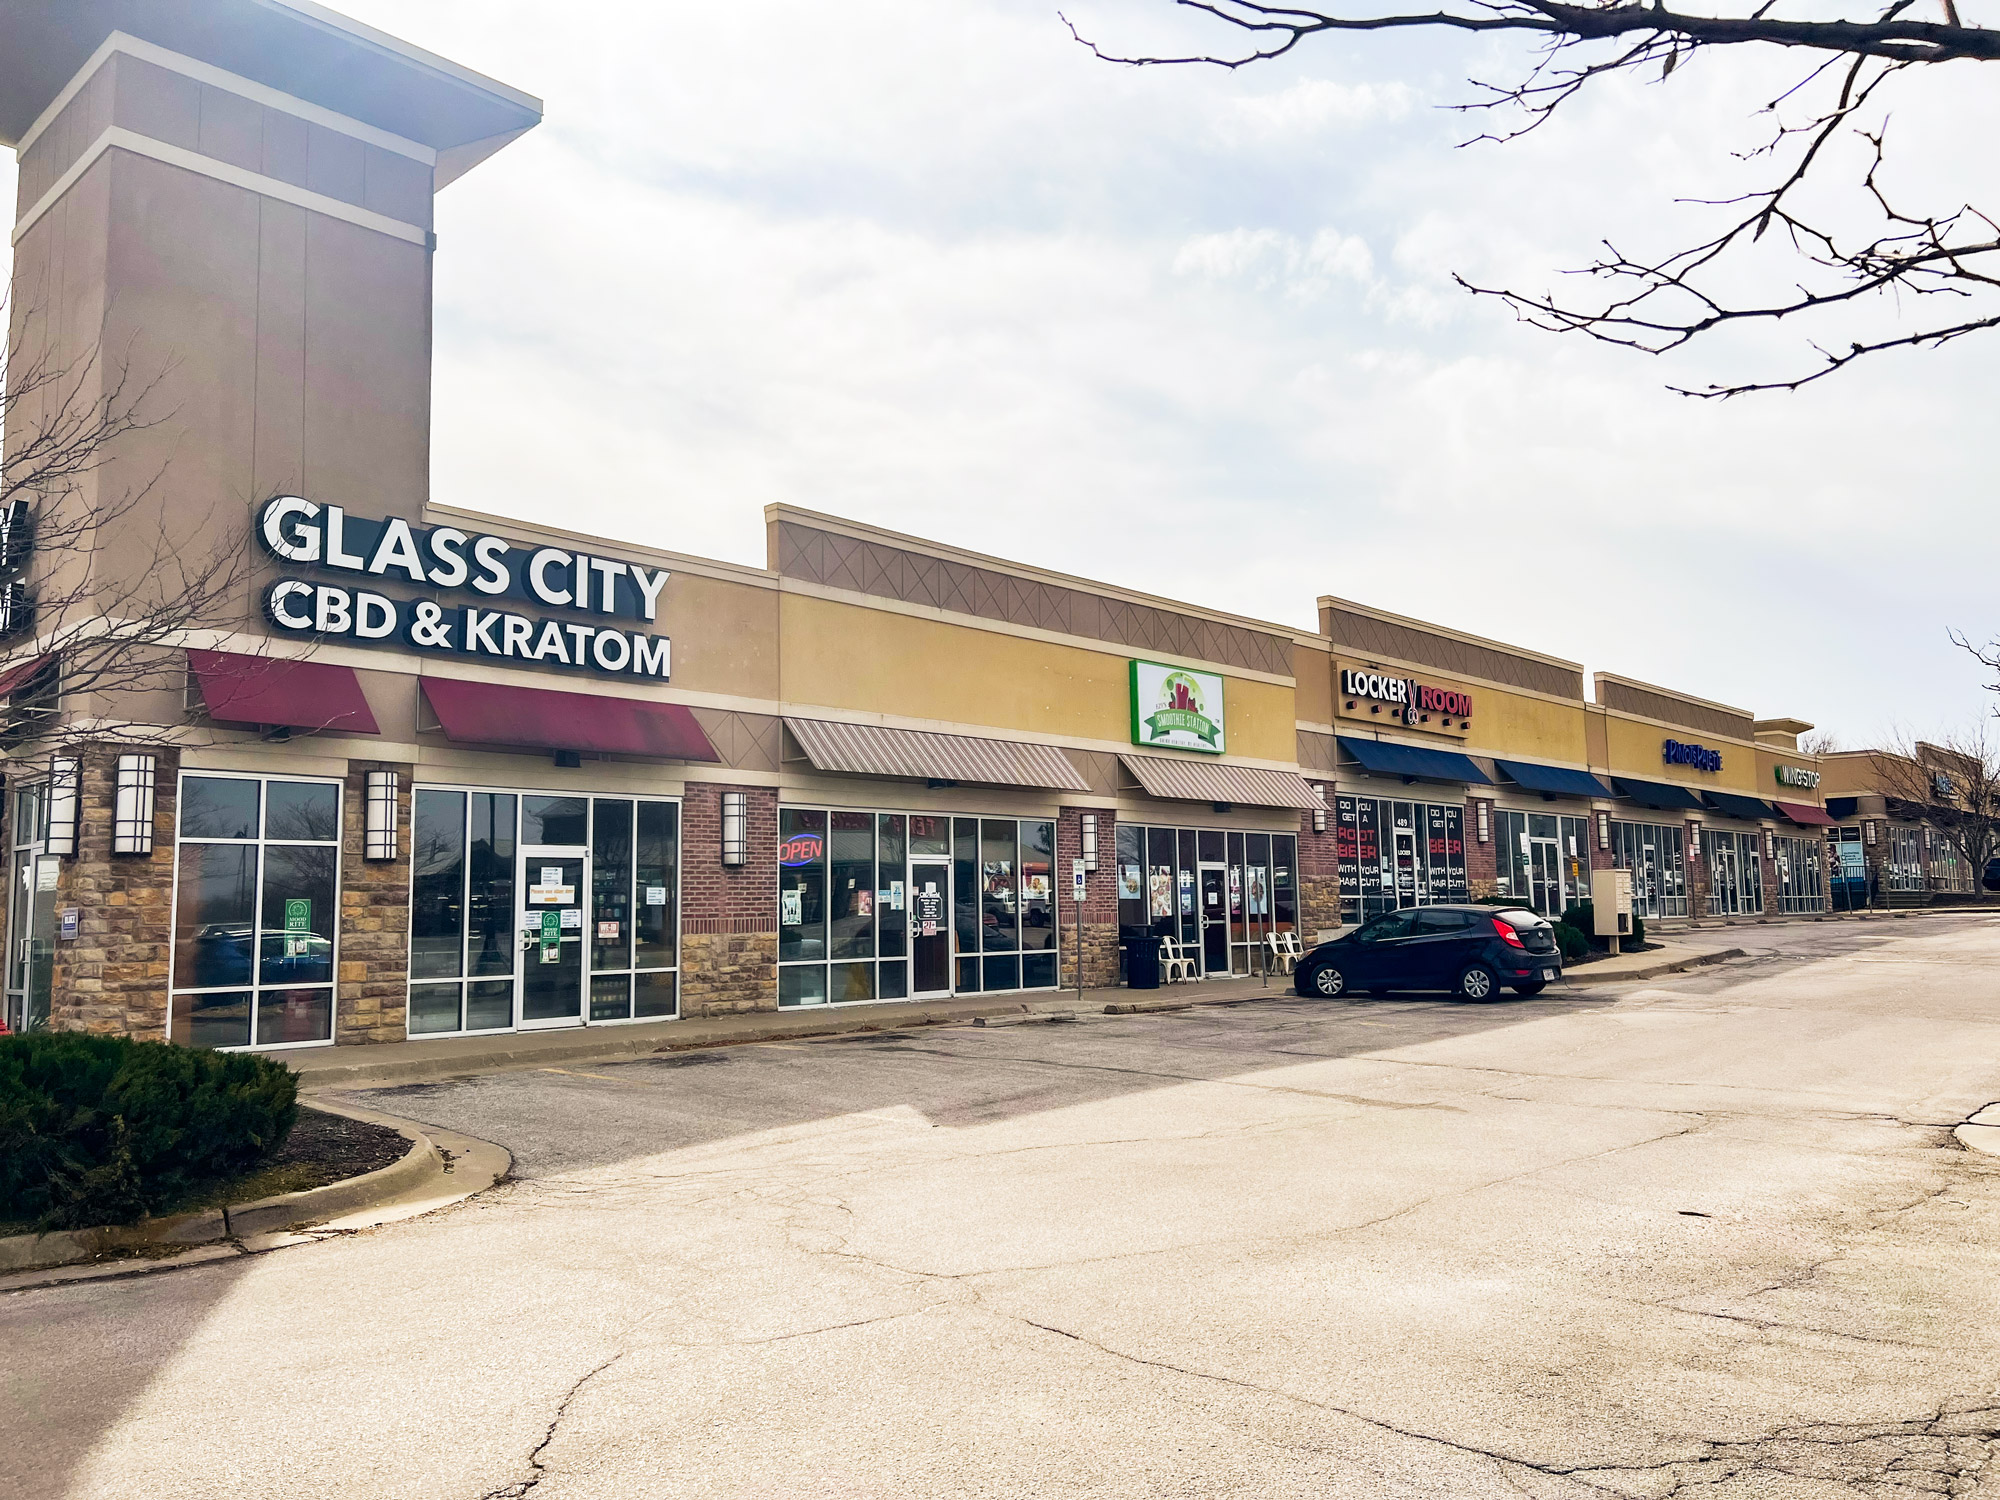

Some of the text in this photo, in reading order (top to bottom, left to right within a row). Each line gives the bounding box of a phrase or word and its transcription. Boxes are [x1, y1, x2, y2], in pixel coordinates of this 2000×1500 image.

[262, 495, 671, 620] GLASS CITY
[271, 581, 671, 677] CBD & KRATOM
[1346, 669, 1473, 717] LOCKER ROOM
[1157, 713, 1210, 734] SMOOTHIE STATION
[1339, 800, 1371, 811] DO YOU
[1342, 813, 1369, 823] GET A
[1430, 808, 1457, 818] DO YOU
[1397, 818, 1408, 827] 489
[1432, 820, 1455, 829] GET A
[1337, 827, 1375, 842] ROOT
[779, 840, 823, 861] OPEN
[1337, 843, 1377, 859] BEER
[1429, 838, 1462, 854] BEER
[1337, 864, 1379, 875] WITH YOUR
[1430, 866, 1464, 876] WITH YOUR
[1339, 877, 1380, 887] HAIR CUT?
[1430, 879, 1465, 888] HAIR CUT?
[923, 921, 935, 929] 21+
